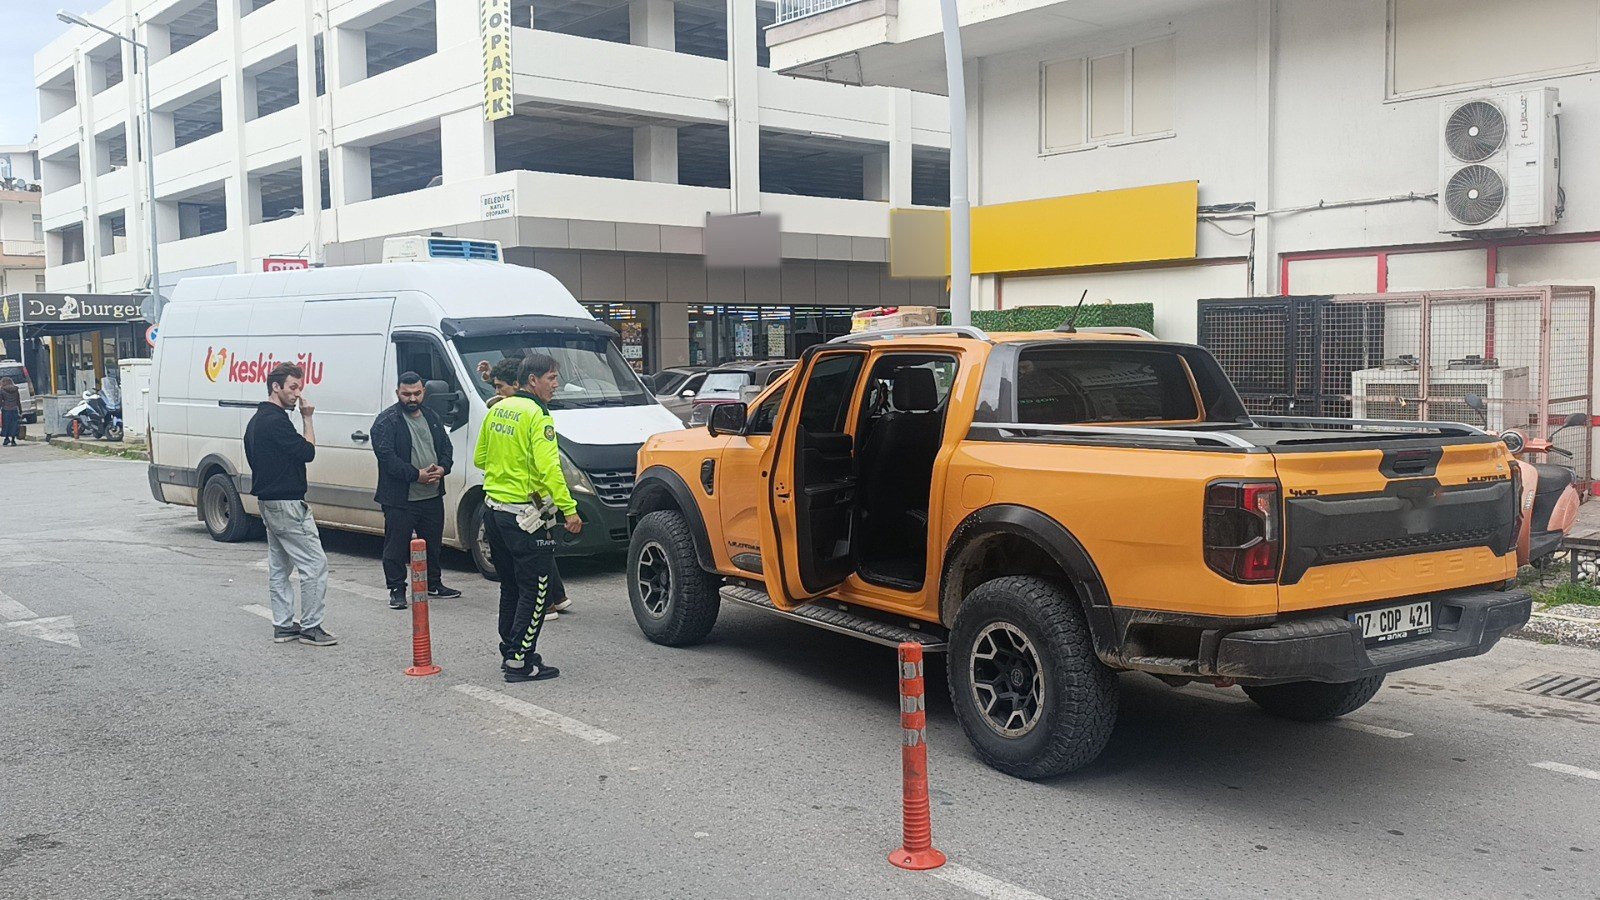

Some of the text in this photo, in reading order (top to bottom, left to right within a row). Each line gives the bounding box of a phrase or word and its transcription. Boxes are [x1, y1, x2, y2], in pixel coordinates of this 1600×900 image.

[81, 301, 143, 317] burger
[493, 408, 522, 422] TRAFİK
[1289, 488, 1318, 497] 4WD
[1379, 608, 1402, 633] CDP
[1409, 603, 1430, 628] 421
[1386, 631, 1408, 641] anka
